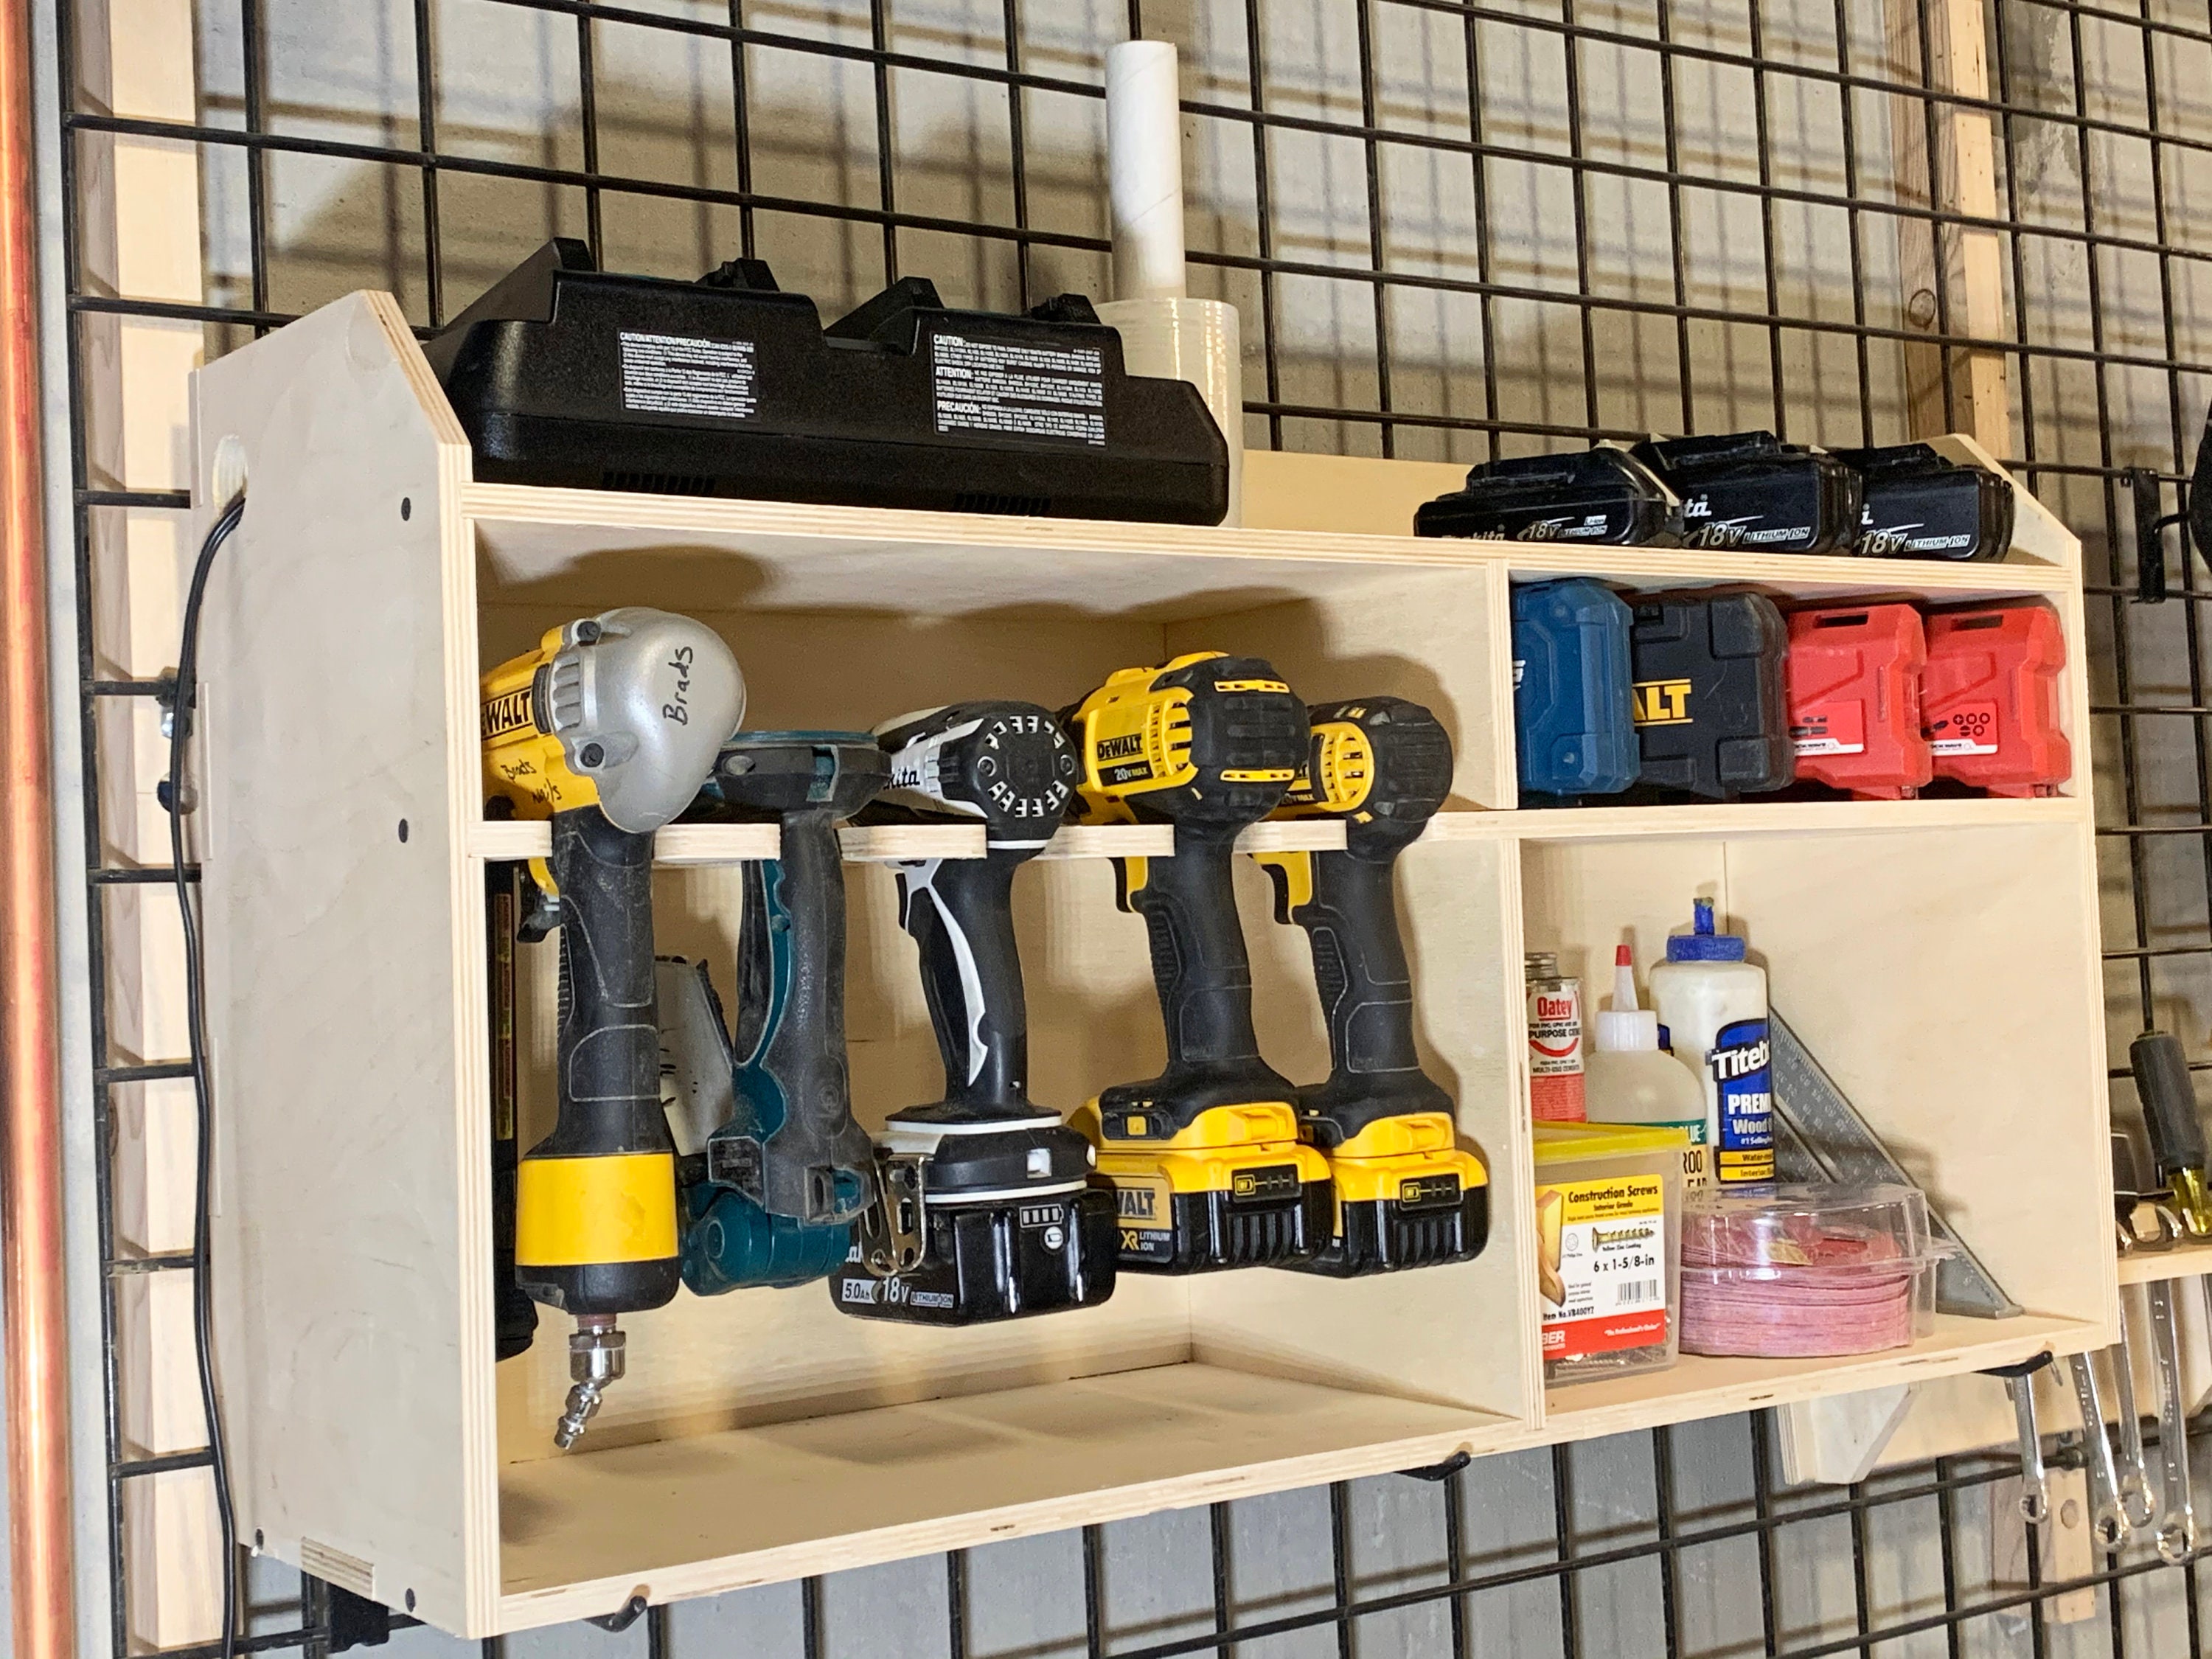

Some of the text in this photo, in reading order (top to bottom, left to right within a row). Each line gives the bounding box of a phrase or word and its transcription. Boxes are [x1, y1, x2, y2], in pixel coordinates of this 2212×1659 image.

[663, 646, 694, 726] Brads
[1537, 997, 1572, 1019] Oatey
[1528, 1029, 1567, 1039] PURPOSE
[1711, 1040, 1770, 1079] Titeb
[1733, 1118, 1767, 1135] Wood
[1568, 1185, 1658, 1203] Construction Screws
[1121, 1230, 1170, 1251] XR LITHIUM
[1140, 1242, 1155, 1251] ION
[1593, 1261, 1600, 1273] 6
[1603, 1262, 1609, 1272] x
[882, 1276, 910, 1304] 18V
